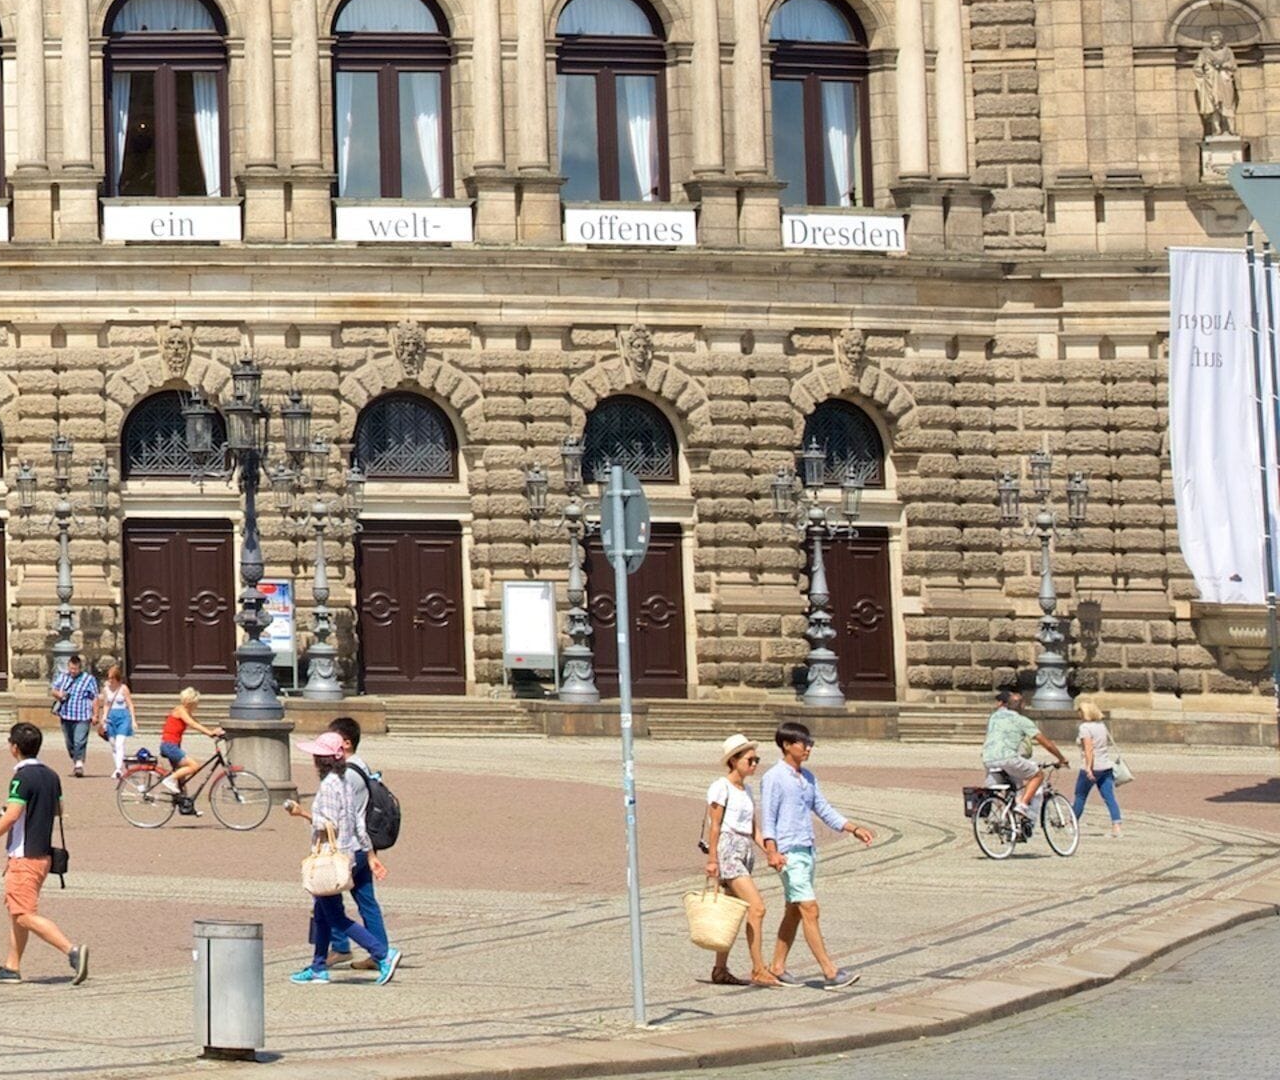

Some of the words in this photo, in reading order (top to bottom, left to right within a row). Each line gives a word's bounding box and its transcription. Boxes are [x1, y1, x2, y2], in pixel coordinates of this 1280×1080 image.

[150, 211, 194, 237] ein
[368, 212, 441, 238] welt-
[580, 215, 683, 242] offenes
[788, 218, 900, 247] Dresden
